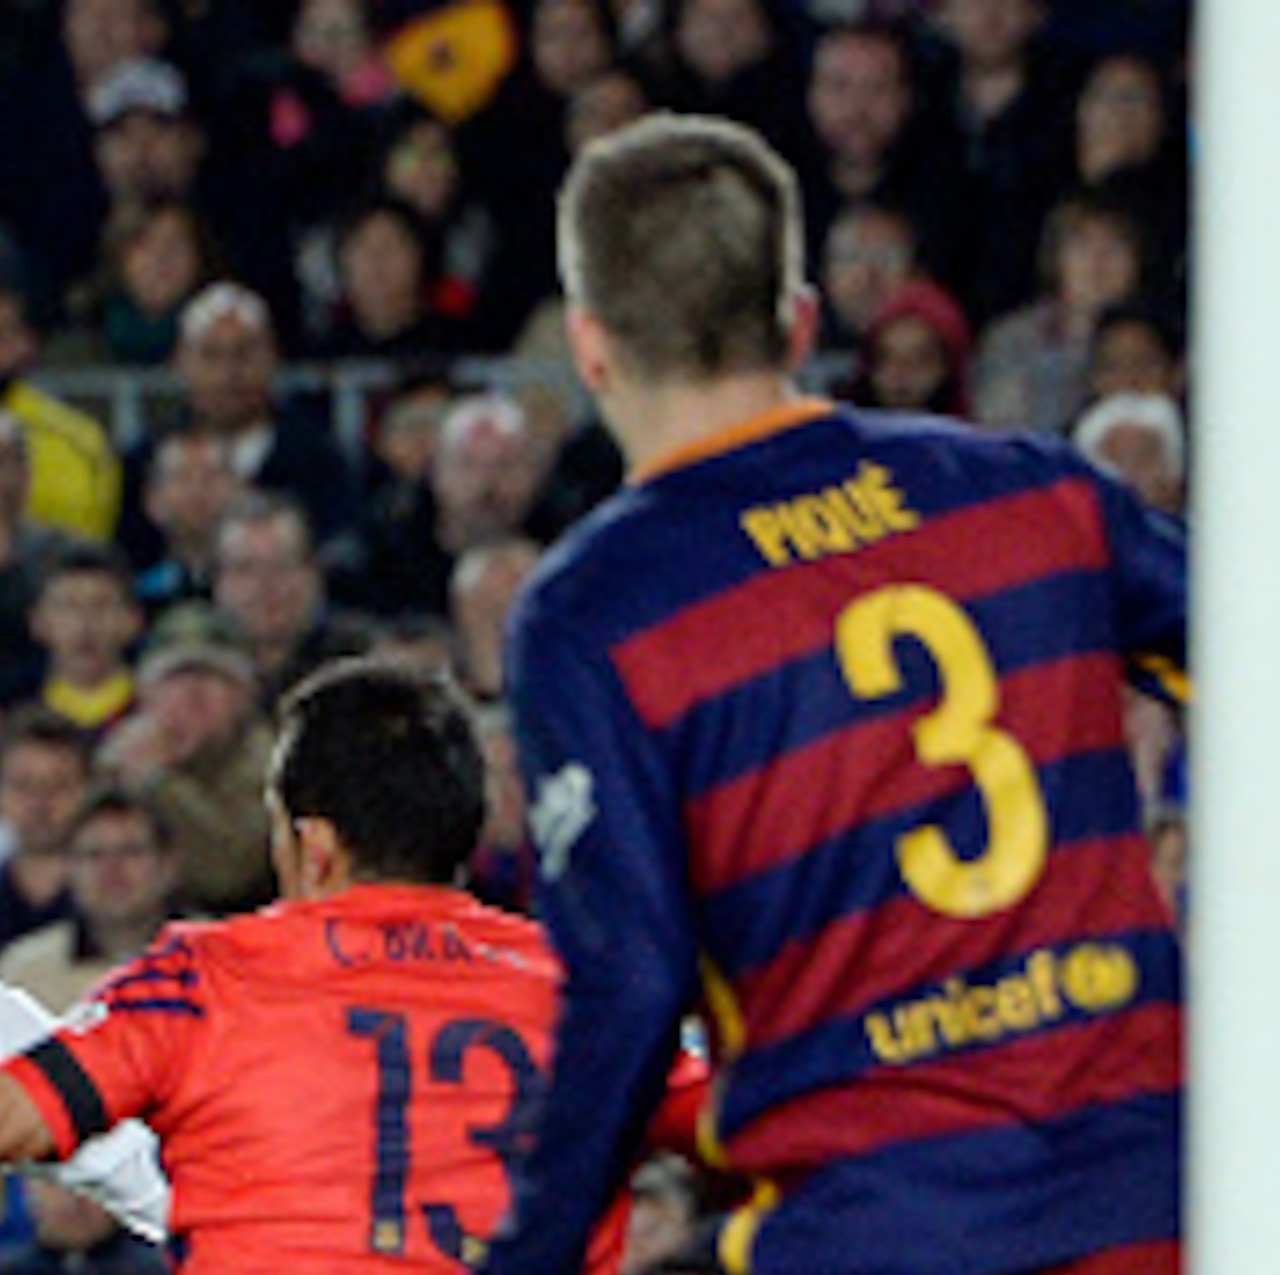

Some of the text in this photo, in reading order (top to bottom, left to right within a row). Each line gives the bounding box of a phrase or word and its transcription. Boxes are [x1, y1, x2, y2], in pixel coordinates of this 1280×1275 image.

[740, 458, 921, 566] PIQUÉ
[833, 581, 1048, 919] 3
[863, 948, 1064, 1064] unicef
[345, 1005, 548, 1272] 13
